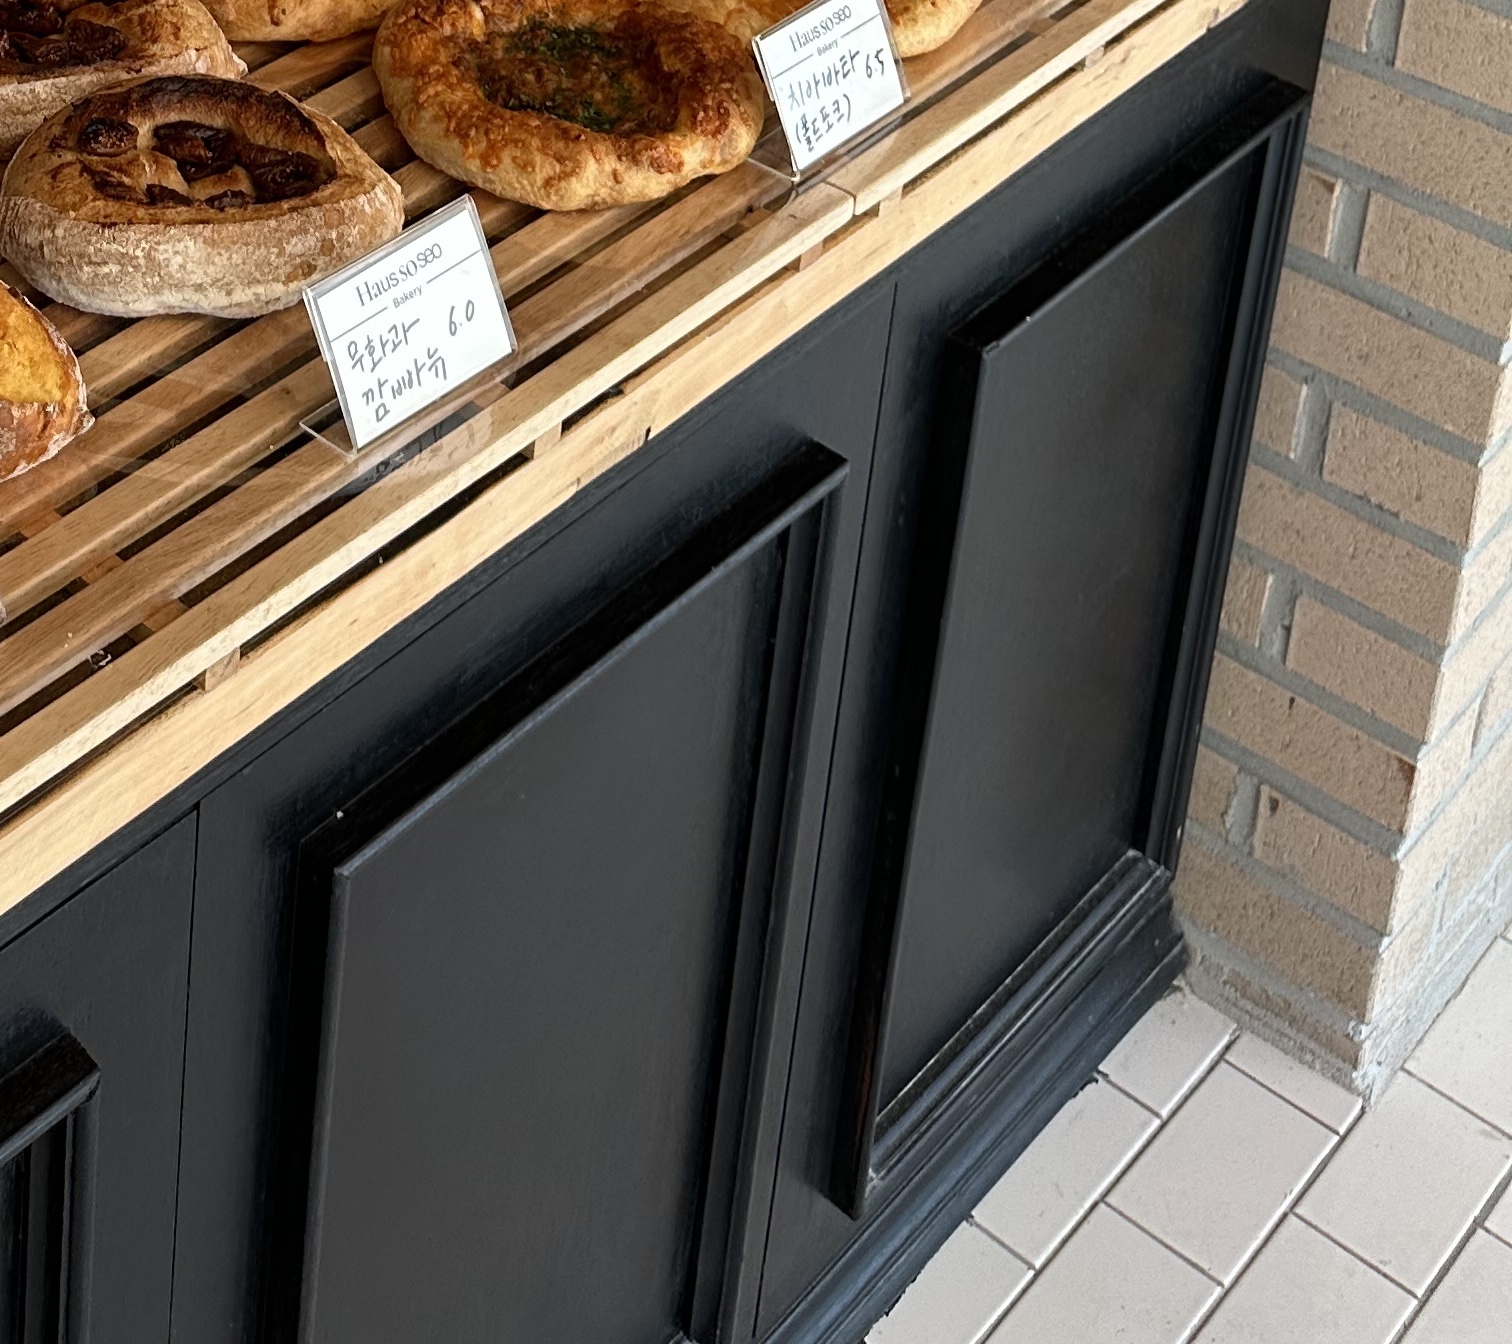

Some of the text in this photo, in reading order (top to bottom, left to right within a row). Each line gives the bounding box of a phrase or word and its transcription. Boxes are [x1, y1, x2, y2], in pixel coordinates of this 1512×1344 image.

[787, 47, 884, 112] 치아바타 6.5
[392, 284, 423, 309] Bakery
[347, 299, 475, 373] 무화과 6.0
[361, 346, 448, 424] 깜빠뉴
